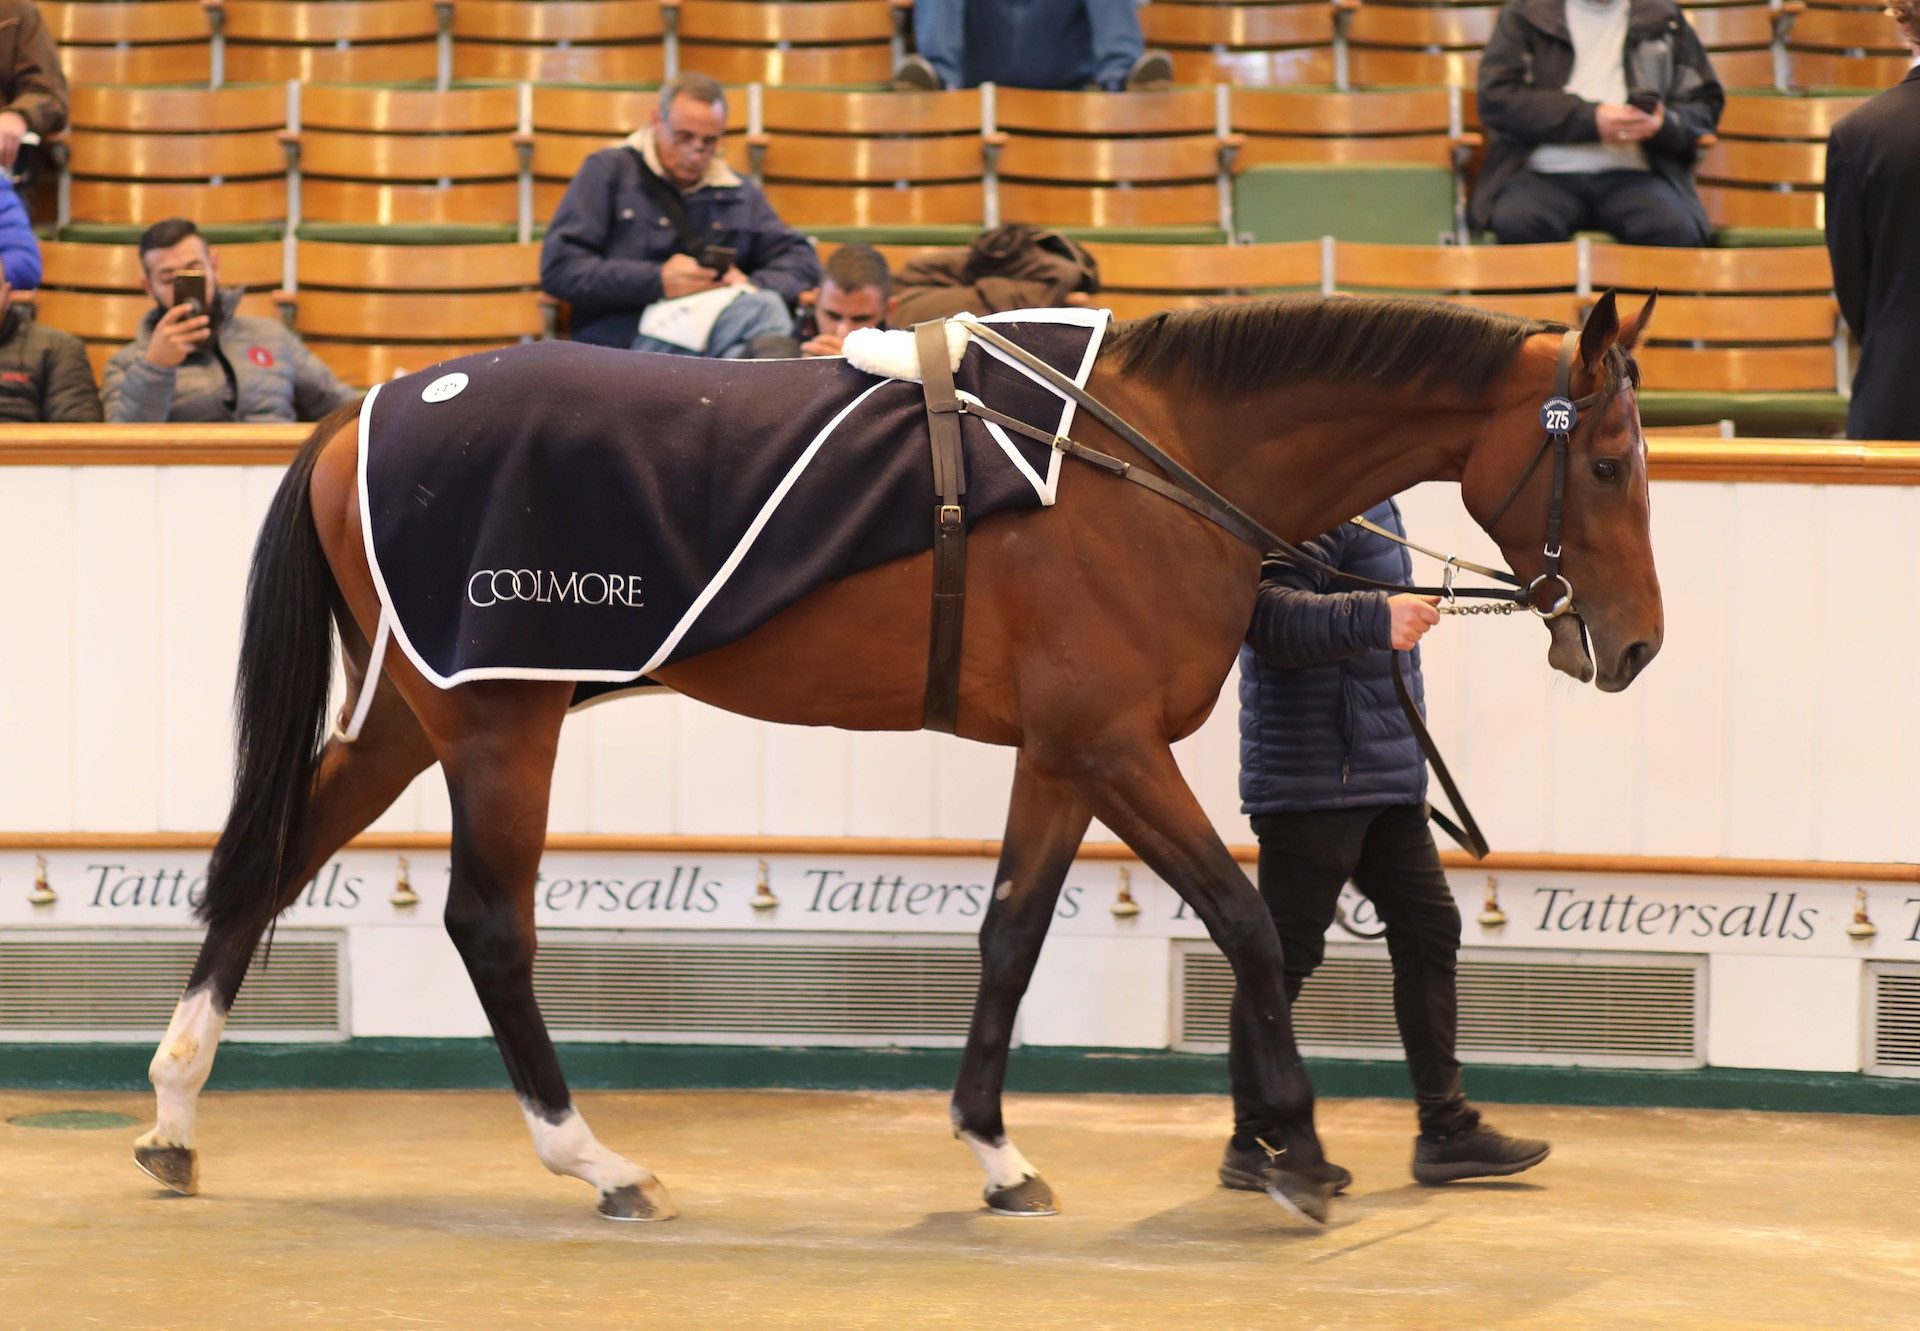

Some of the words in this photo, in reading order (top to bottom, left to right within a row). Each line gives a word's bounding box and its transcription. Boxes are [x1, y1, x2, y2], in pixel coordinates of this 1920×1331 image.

[1546, 410, 1570, 430] 275
[468, 569, 644, 608] COOLMORE
[87, 862, 364, 909] Tattells
[805, 869, 1084, 919] Tatterss
[1533, 888, 1819, 940] Tattersalls
